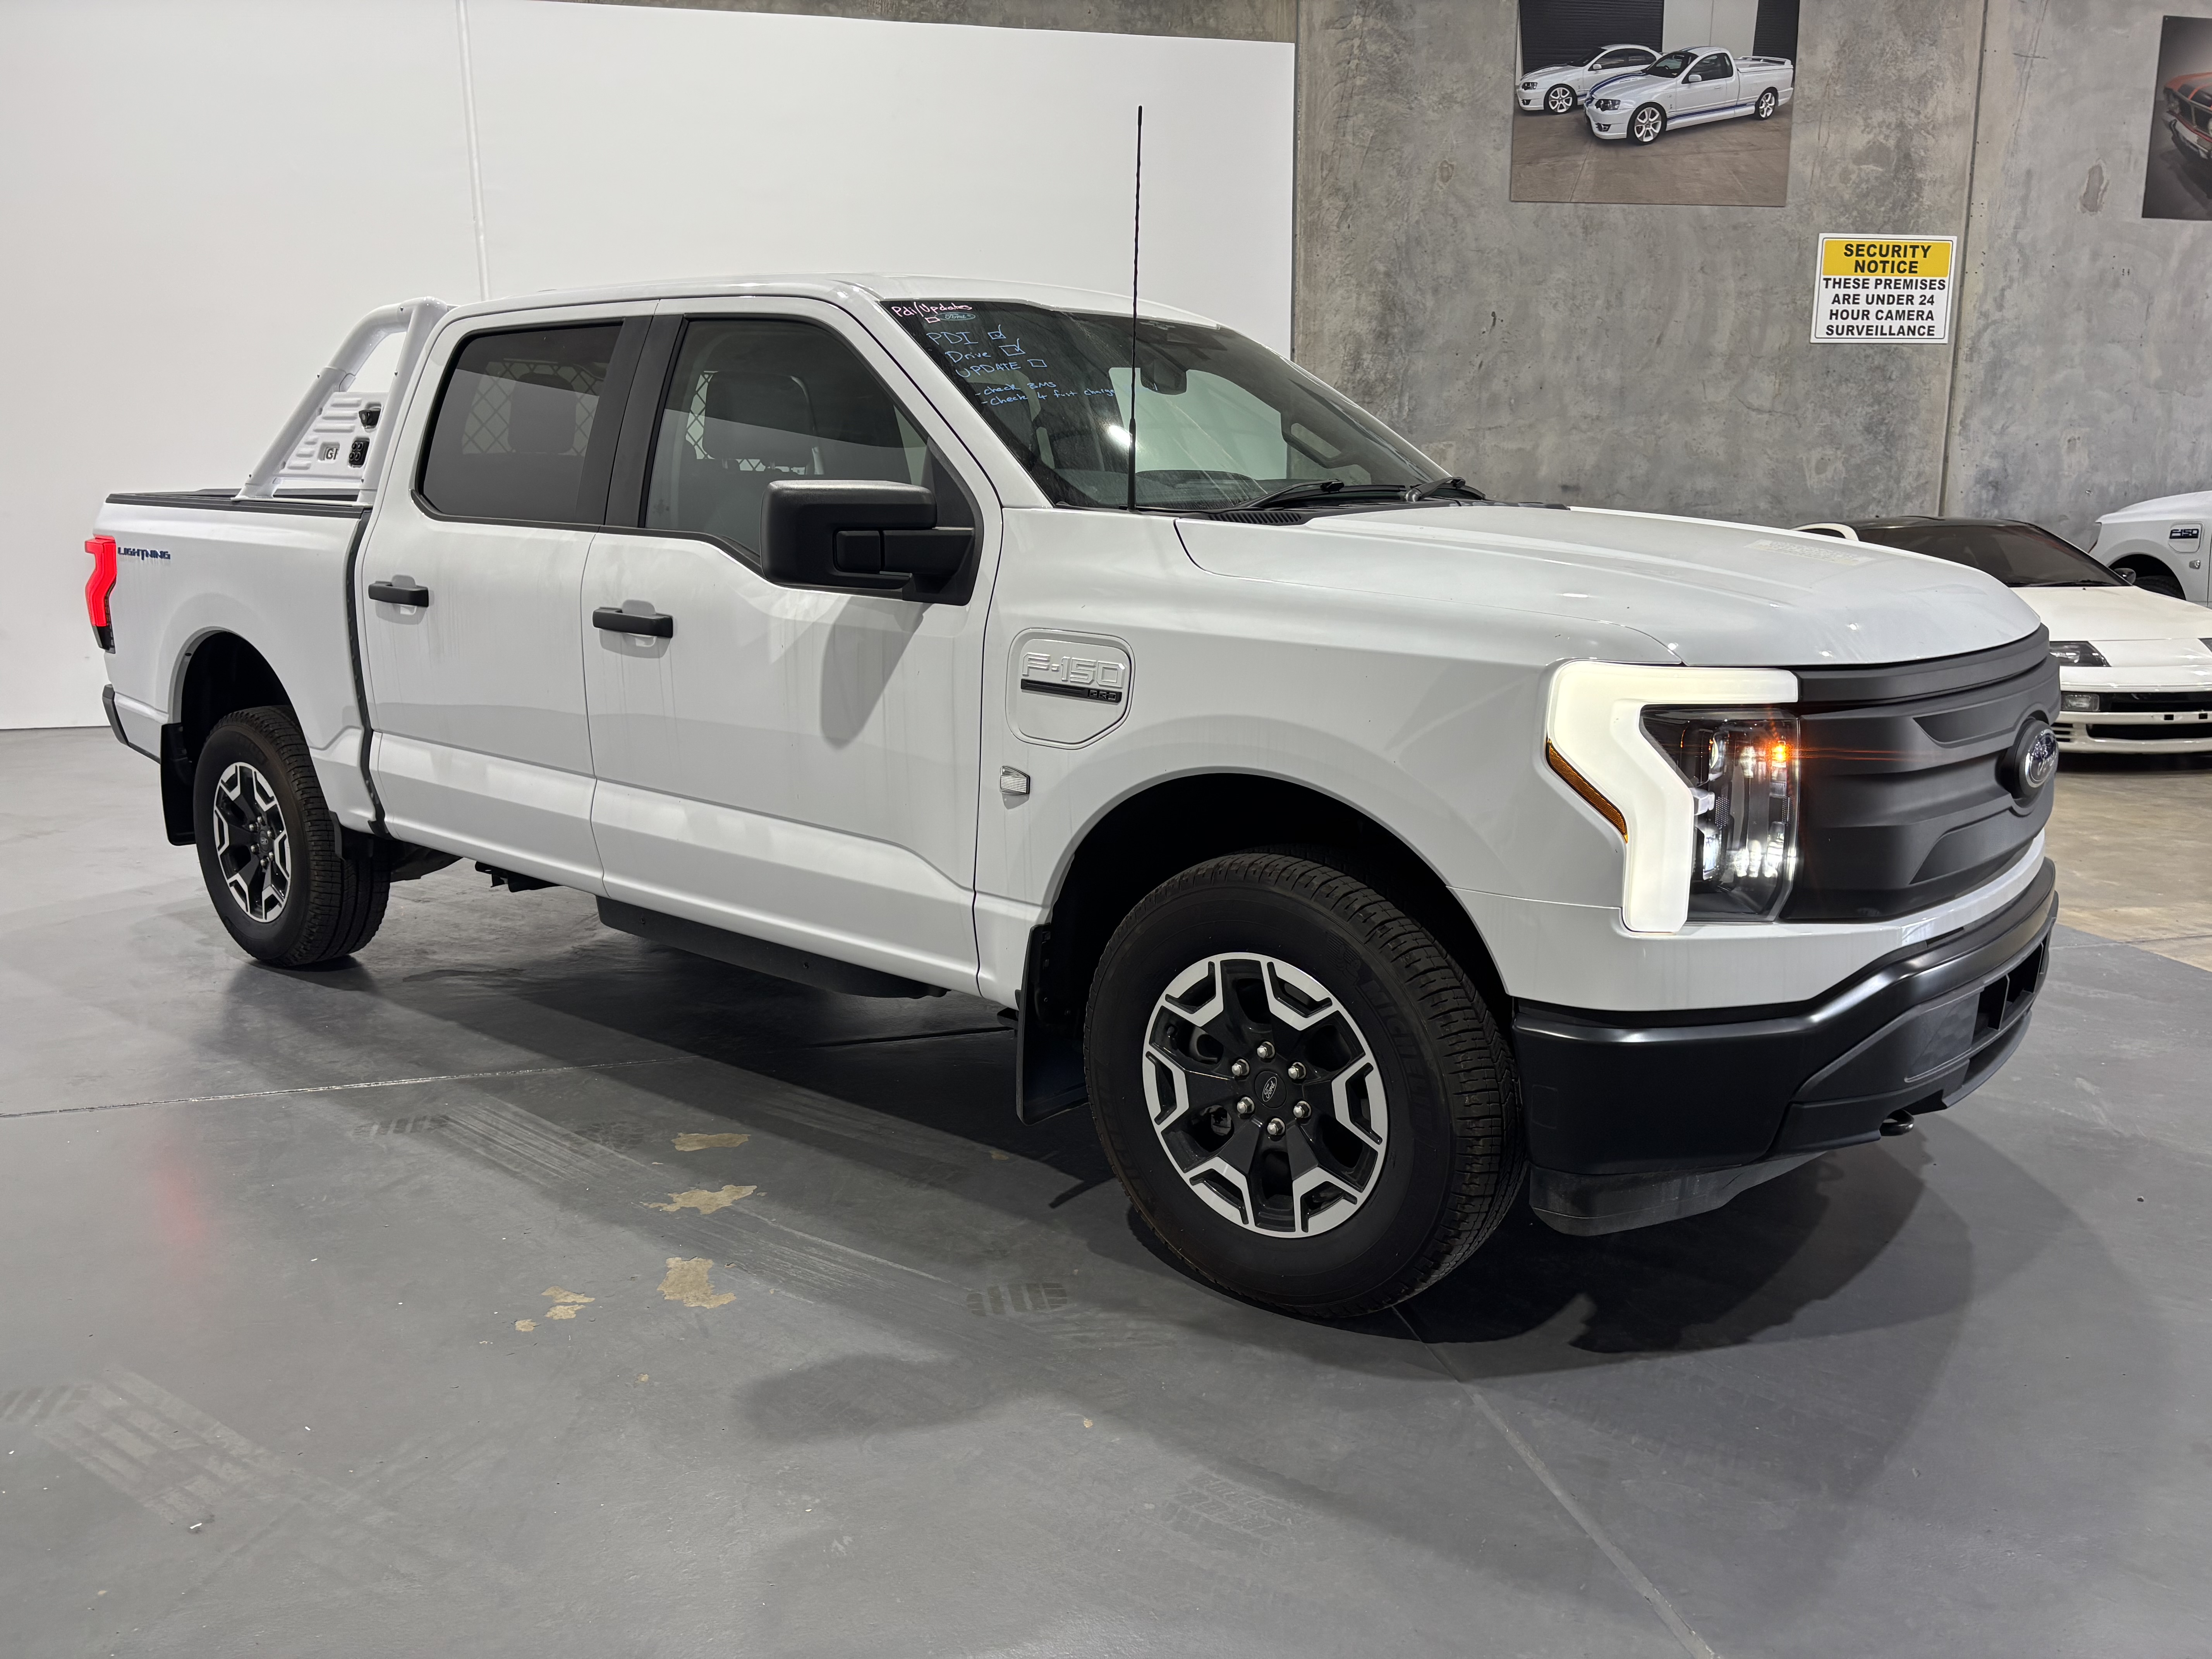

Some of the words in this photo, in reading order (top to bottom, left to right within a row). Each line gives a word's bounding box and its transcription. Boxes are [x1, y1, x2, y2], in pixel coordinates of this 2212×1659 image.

[1844, 244, 1932, 258] SECURITY
[1854, 260, 1918, 274] NOTICE
[1823, 278, 1870, 289] THESE
[1874, 278, 1946, 290] PREMISES
[1831, 294, 1860, 305] ARE
[1865, 294, 1914, 305] UNDER
[1918, 294, 1935, 306] 24
[1829, 309, 1870, 321] HOUR
[1875, 309, 1934, 321] CAMERA
[1826, 325, 1935, 336] SURVEILLANCE
[926, 332, 979, 345] PDI
[945, 351, 991, 363] Drive
[955, 362, 1021, 378] UPDATE
[1027, 381, 1056, 390] BMS
[118, 547, 170, 560] LIGHTNING
[1022, 652, 1125, 688] F-150
[1264, 1080, 1276, 1099] Ford
